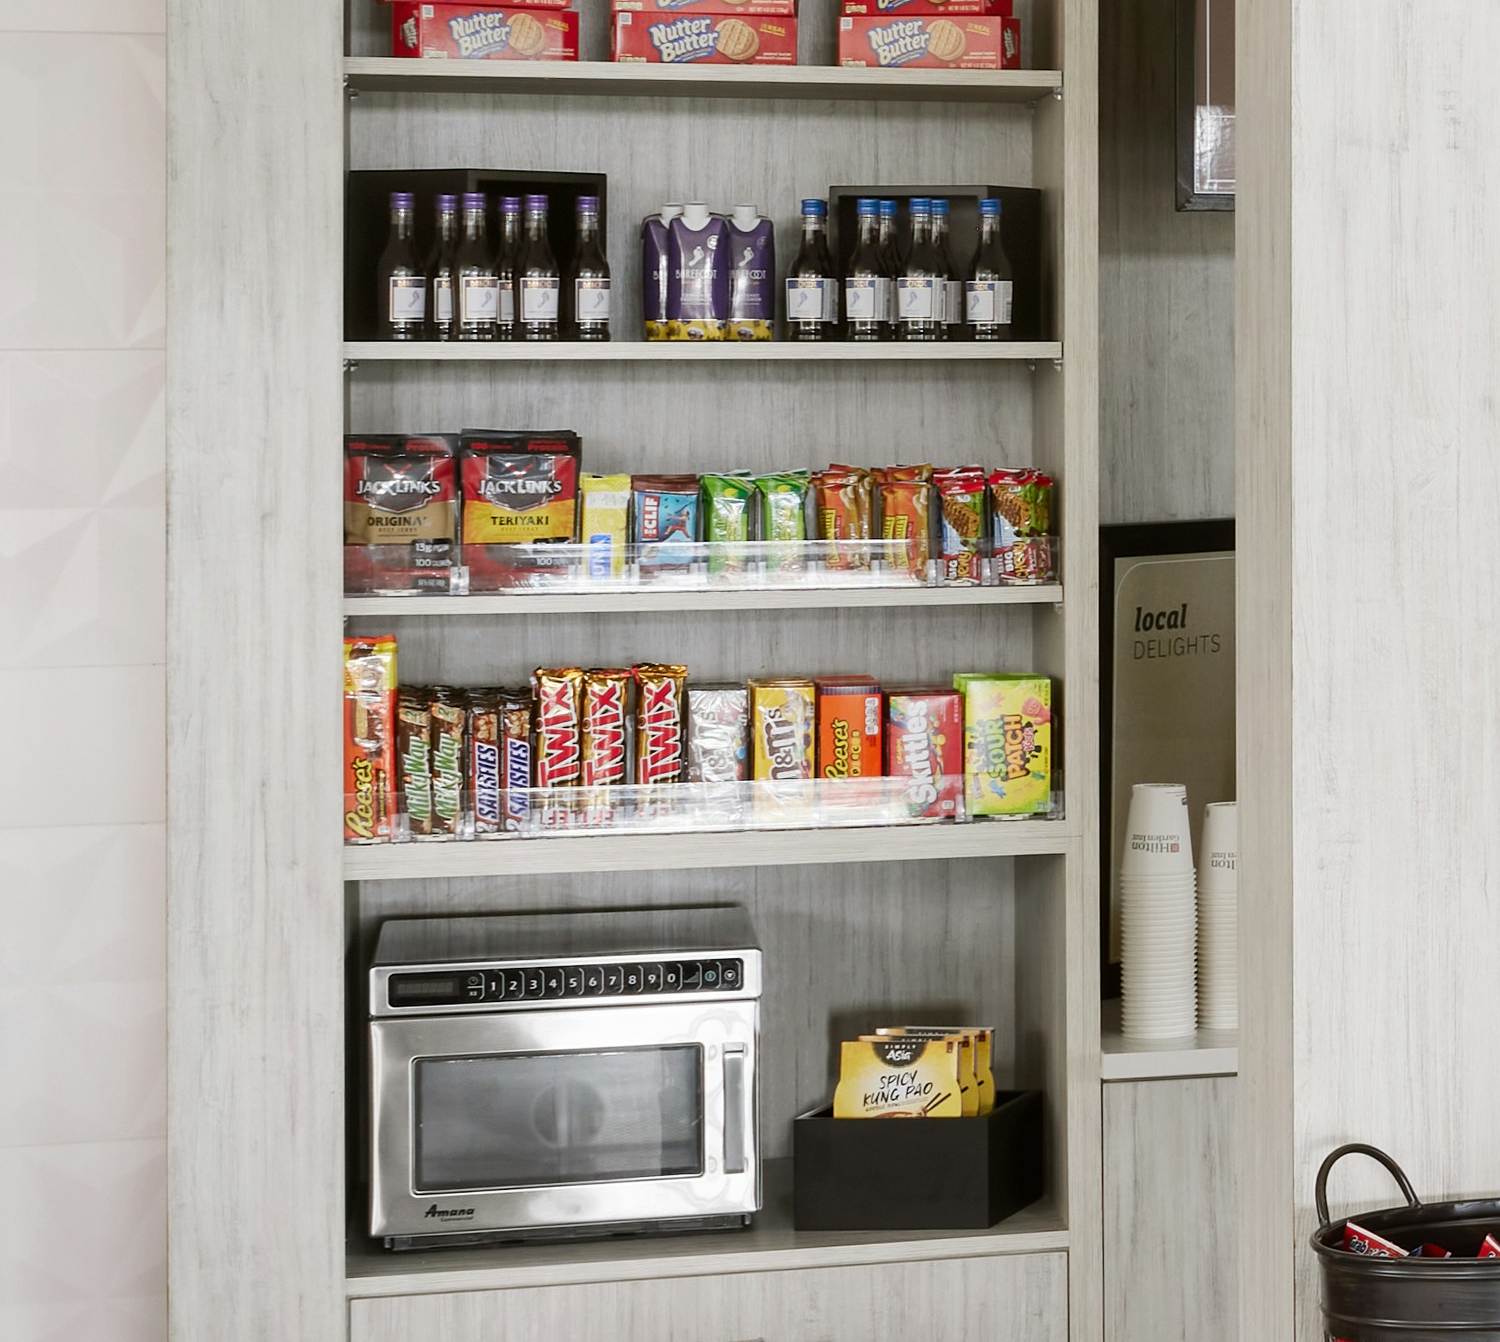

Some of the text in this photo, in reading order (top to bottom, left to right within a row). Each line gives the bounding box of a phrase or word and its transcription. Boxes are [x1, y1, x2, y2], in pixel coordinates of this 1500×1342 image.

[450, 13, 503, 39] Nutter
[650, 18, 711, 46] Nutter
[869, 20, 923, 48] Nutter
[458, 26, 510, 57] Butter
[660, 31, 719, 62] Butter
[876, 33, 930, 66] Butter
[356, 480, 394, 495] JACK
[478, 480, 515, 495] JACK
[490, 516, 549, 526] TERIYAKI
[644, 496, 658, 526] CLIF
[1135, 604, 1188, 632] local
[1133, 634, 1221, 659] DELIGHTS
[539, 682, 580, 787] TWIX
[584, 681, 624, 786] TWIX
[639, 679, 681, 784] TWIX
[902, 700, 938, 804] Skittles
[986, 718, 1007, 779] SOUR
[1004, 714, 1030, 780] PATCH
[1132, 841, 1171, 853] Hilton
[490, 973, 676, 991] 1 2 3 4 5 6 7 8 9 0
[880, 1070, 918, 1090] SPICY
[863, 1082, 933, 1107] KUNG PAO
[424, 1203, 475, 1219] Amana
